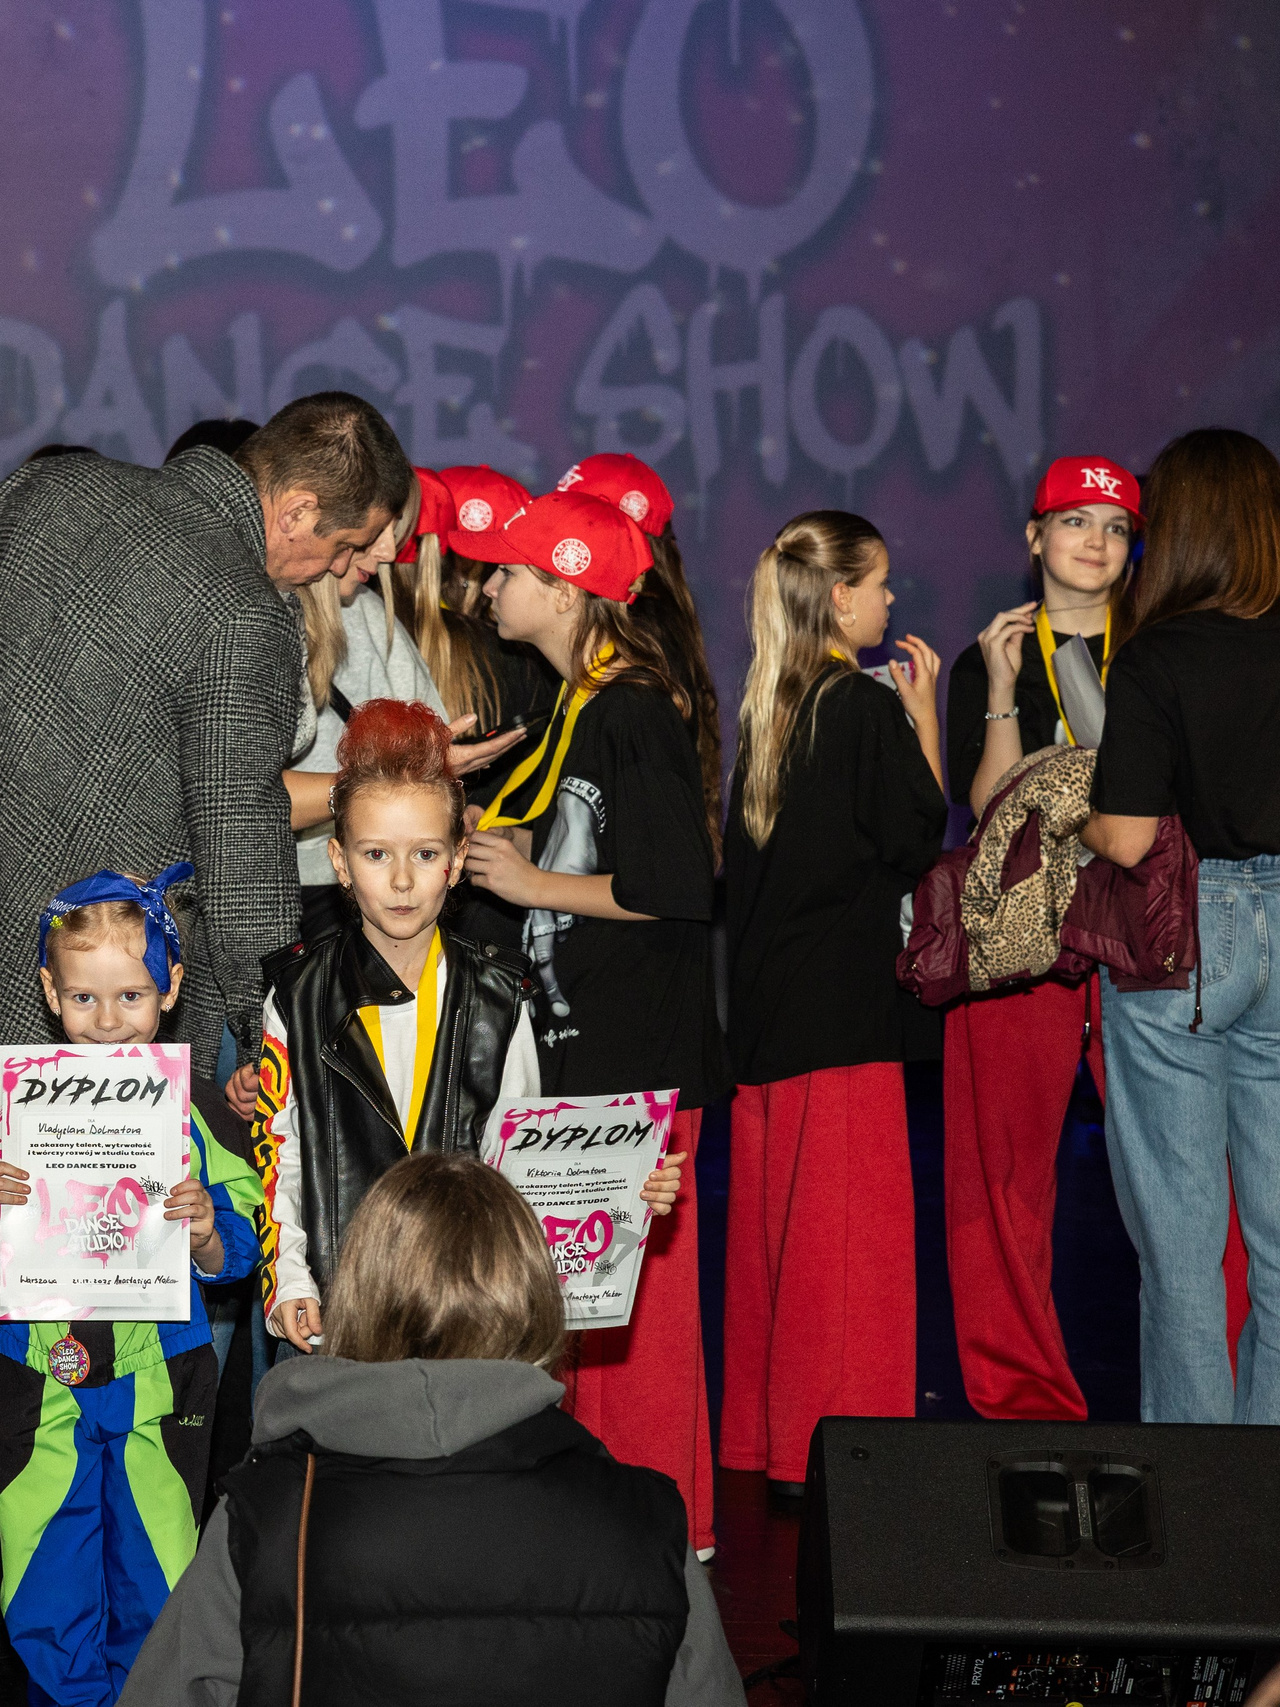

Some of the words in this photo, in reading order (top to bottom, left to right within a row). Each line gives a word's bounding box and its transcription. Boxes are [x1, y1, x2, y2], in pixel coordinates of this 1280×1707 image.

[90, 0, 873, 285] LEO
[575, 283, 1046, 486] SHOW
[1080, 467, 1122, 500] NY
[13, 1074, 169, 1110] DYPLOM
[510, 1119, 654, 1154] DYPLOM
[547, 1188, 573, 1196] rozwój
[34, 1177, 150, 1258] LEO
[64, 1213, 124, 1235] DANCE
[67, 1232, 125, 1252] TUDIO
[541, 1209, 613, 1273] EO
[20, 1274, 58, 1284] Warszawa
[57, 1355, 79, 1363] DANCE
[62, 1348, 75, 1356] LEO
[59, 1363, 78, 1371] SHOW
[971, 1658, 984, 1686] PRX712
